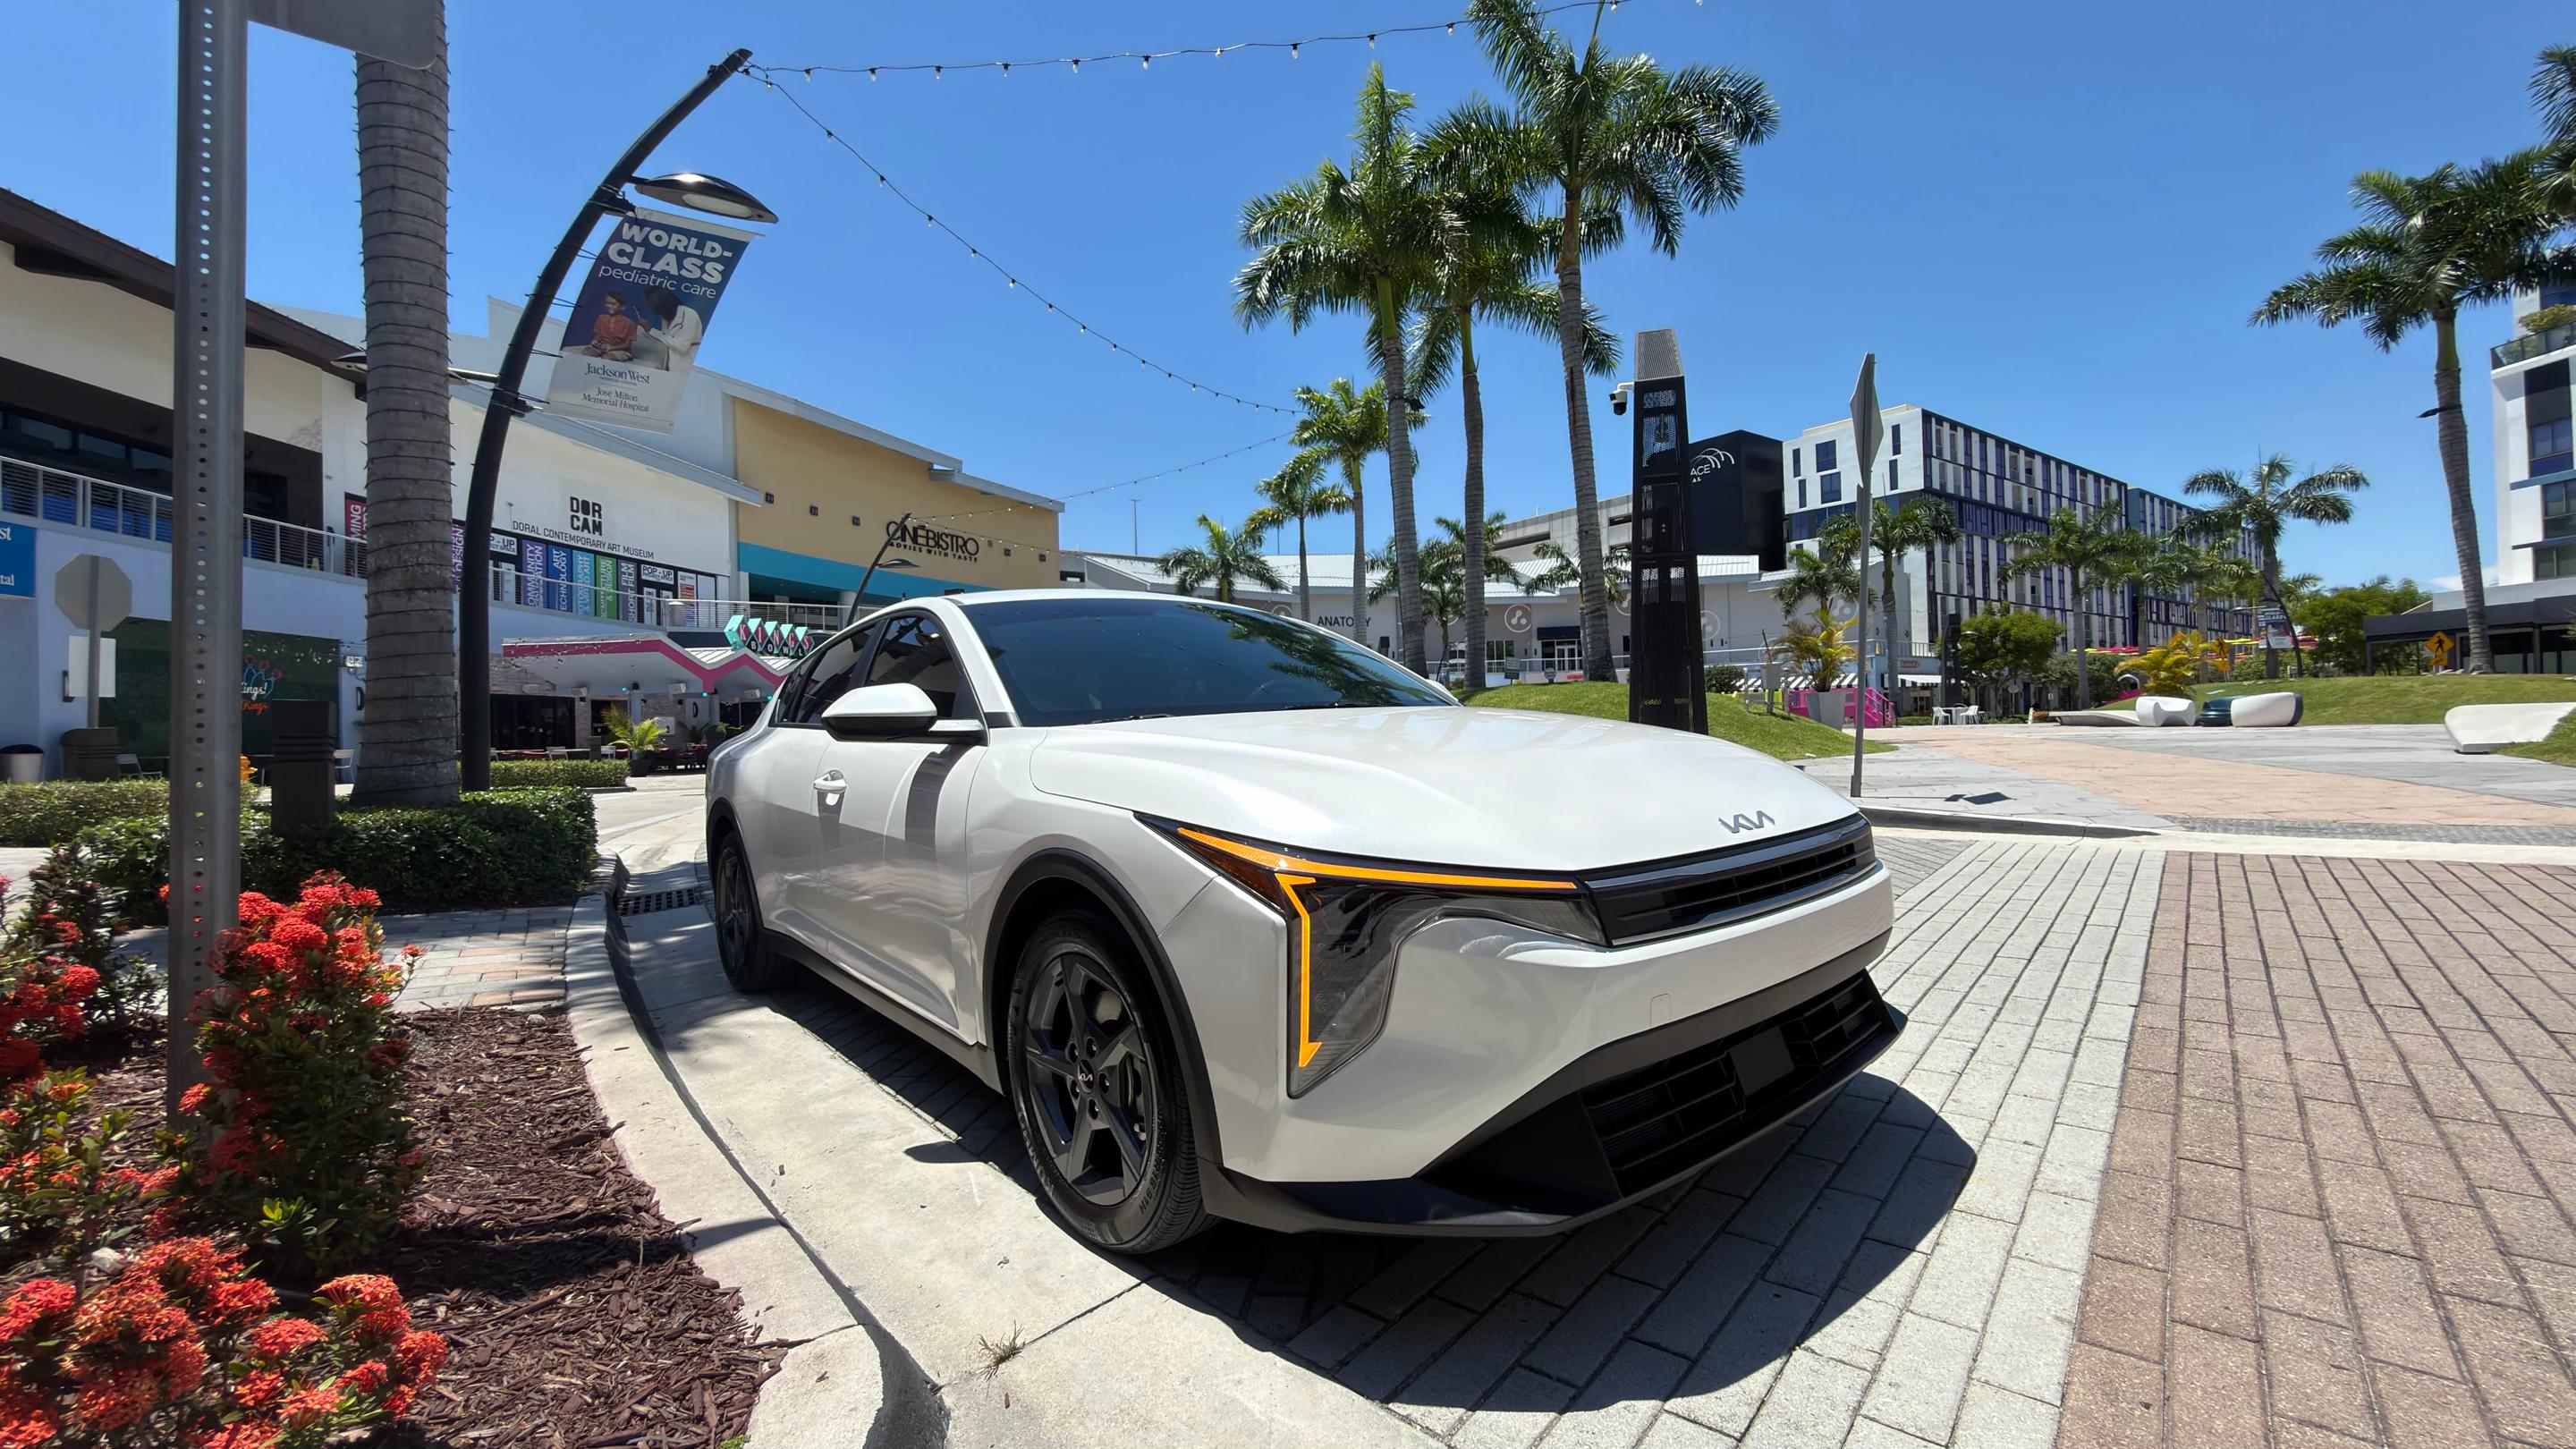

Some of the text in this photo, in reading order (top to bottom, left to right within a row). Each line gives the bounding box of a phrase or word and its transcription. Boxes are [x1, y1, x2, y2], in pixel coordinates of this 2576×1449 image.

[622, 222, 733, 258] WORLD-
[607, 242, 725, 284] CLASS
[598, 265, 716, 299] pediatric care
[584, 362, 627, 380] Jackson
[628, 369, 649, 384] West
[582, 393, 649, 412] Memorial Hospital
[1690, 464, 1711, 476] ACE
[570, 514, 602, 537] CAM
[513, 521, 655, 560] DORAL CONTEMPORARY ART MUSEUM
[553, 548, 561, 569] ART
[527, 544, 536, 606] OMMUNITY
[1318, 615, 1371, 627] ANATOY
[740, 623, 809, 650] KINGS
[751, 640, 803, 656] BOWL
